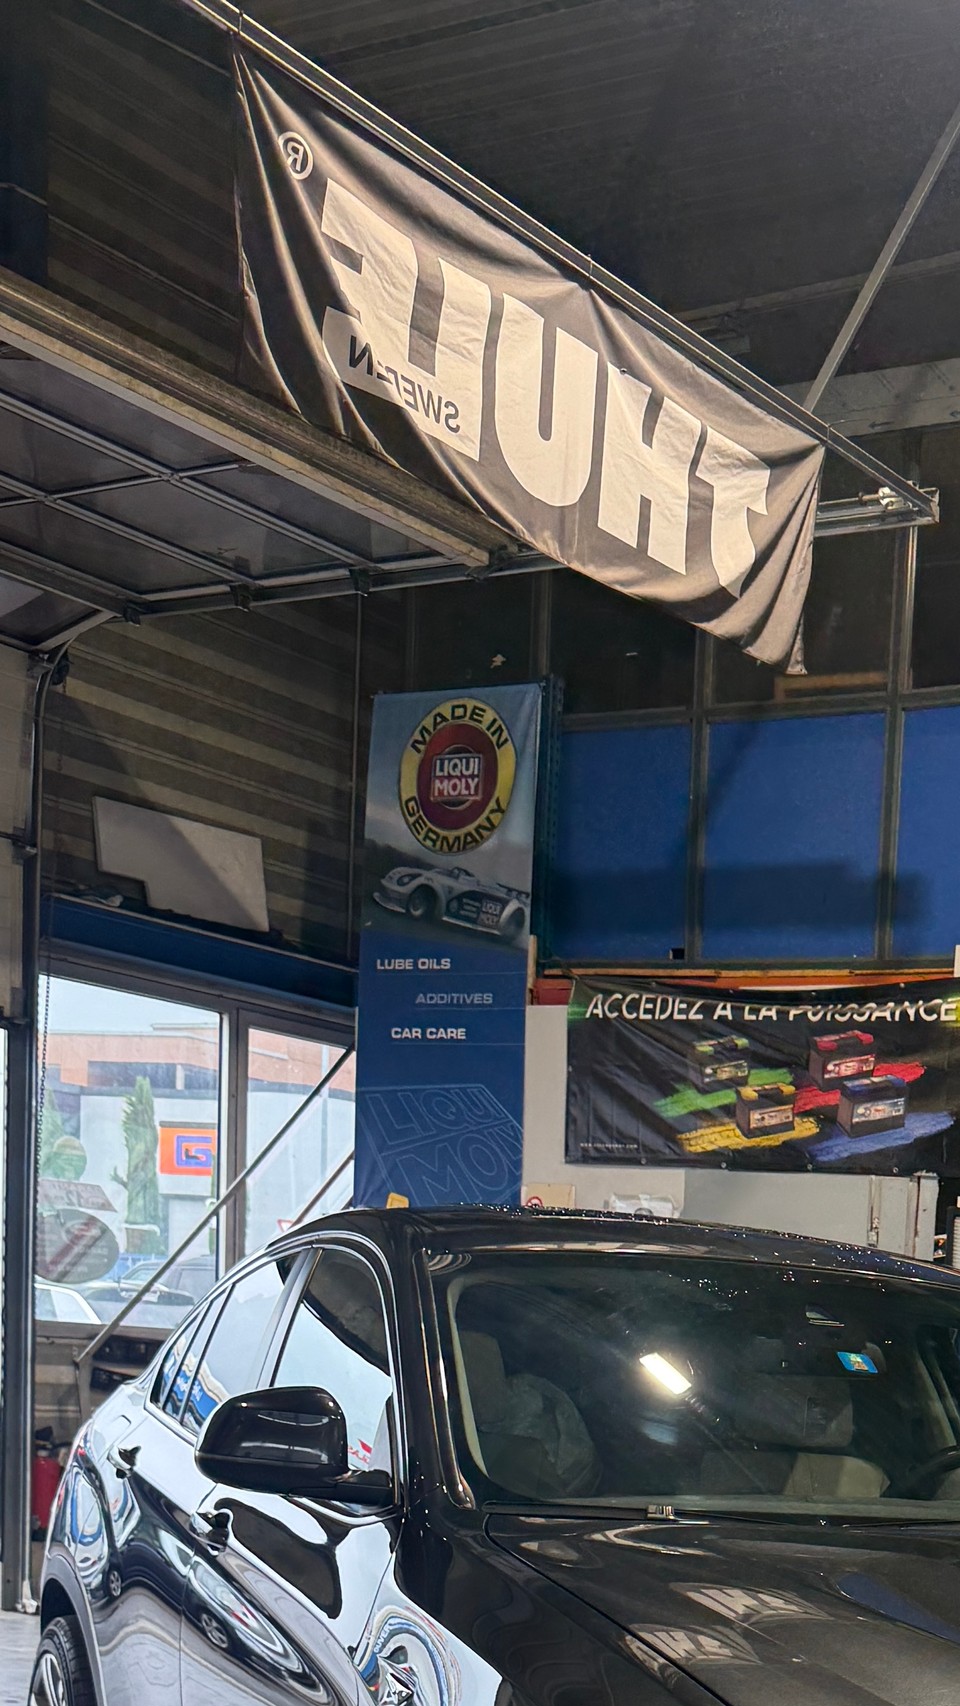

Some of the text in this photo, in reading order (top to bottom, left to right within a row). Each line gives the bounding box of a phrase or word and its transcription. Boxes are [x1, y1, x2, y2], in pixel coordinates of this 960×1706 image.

[410, 703, 510, 754] MADE IN
[435, 757, 480, 777] LIQUI
[434, 777, 479, 797] MOLY
[404, 796, 507, 851] GERMANY
[376, 958, 451, 970] LUBE OILS
[415, 993, 493, 1005] ADDITIVES
[391, 1028, 467, 1040] CAR CARE
[366, 1088, 507, 1145] LIQUI
